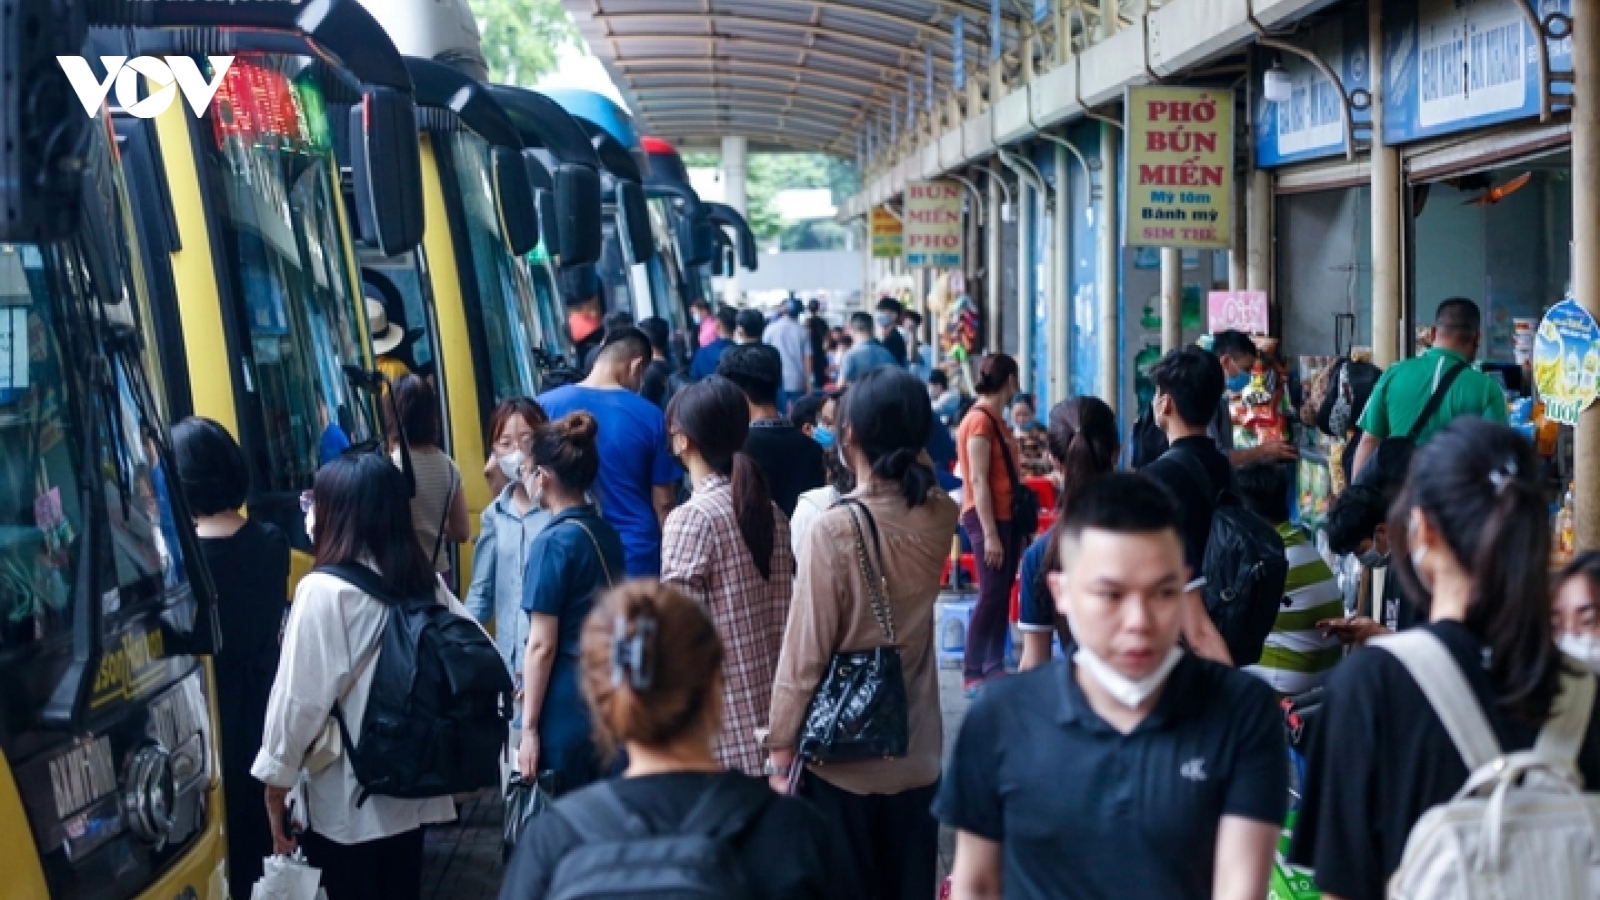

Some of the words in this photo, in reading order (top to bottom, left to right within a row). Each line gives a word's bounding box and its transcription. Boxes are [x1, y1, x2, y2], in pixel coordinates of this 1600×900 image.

[1147, 93, 1217, 123] PHỞ
[1145, 125, 1218, 153] BÚN
[1138, 155, 1225, 187] MIẾN
[1180, 190, 1212, 204] tôm
[1141, 206, 1187, 221] Bánh
[1142, 226, 1175, 240] SIM
